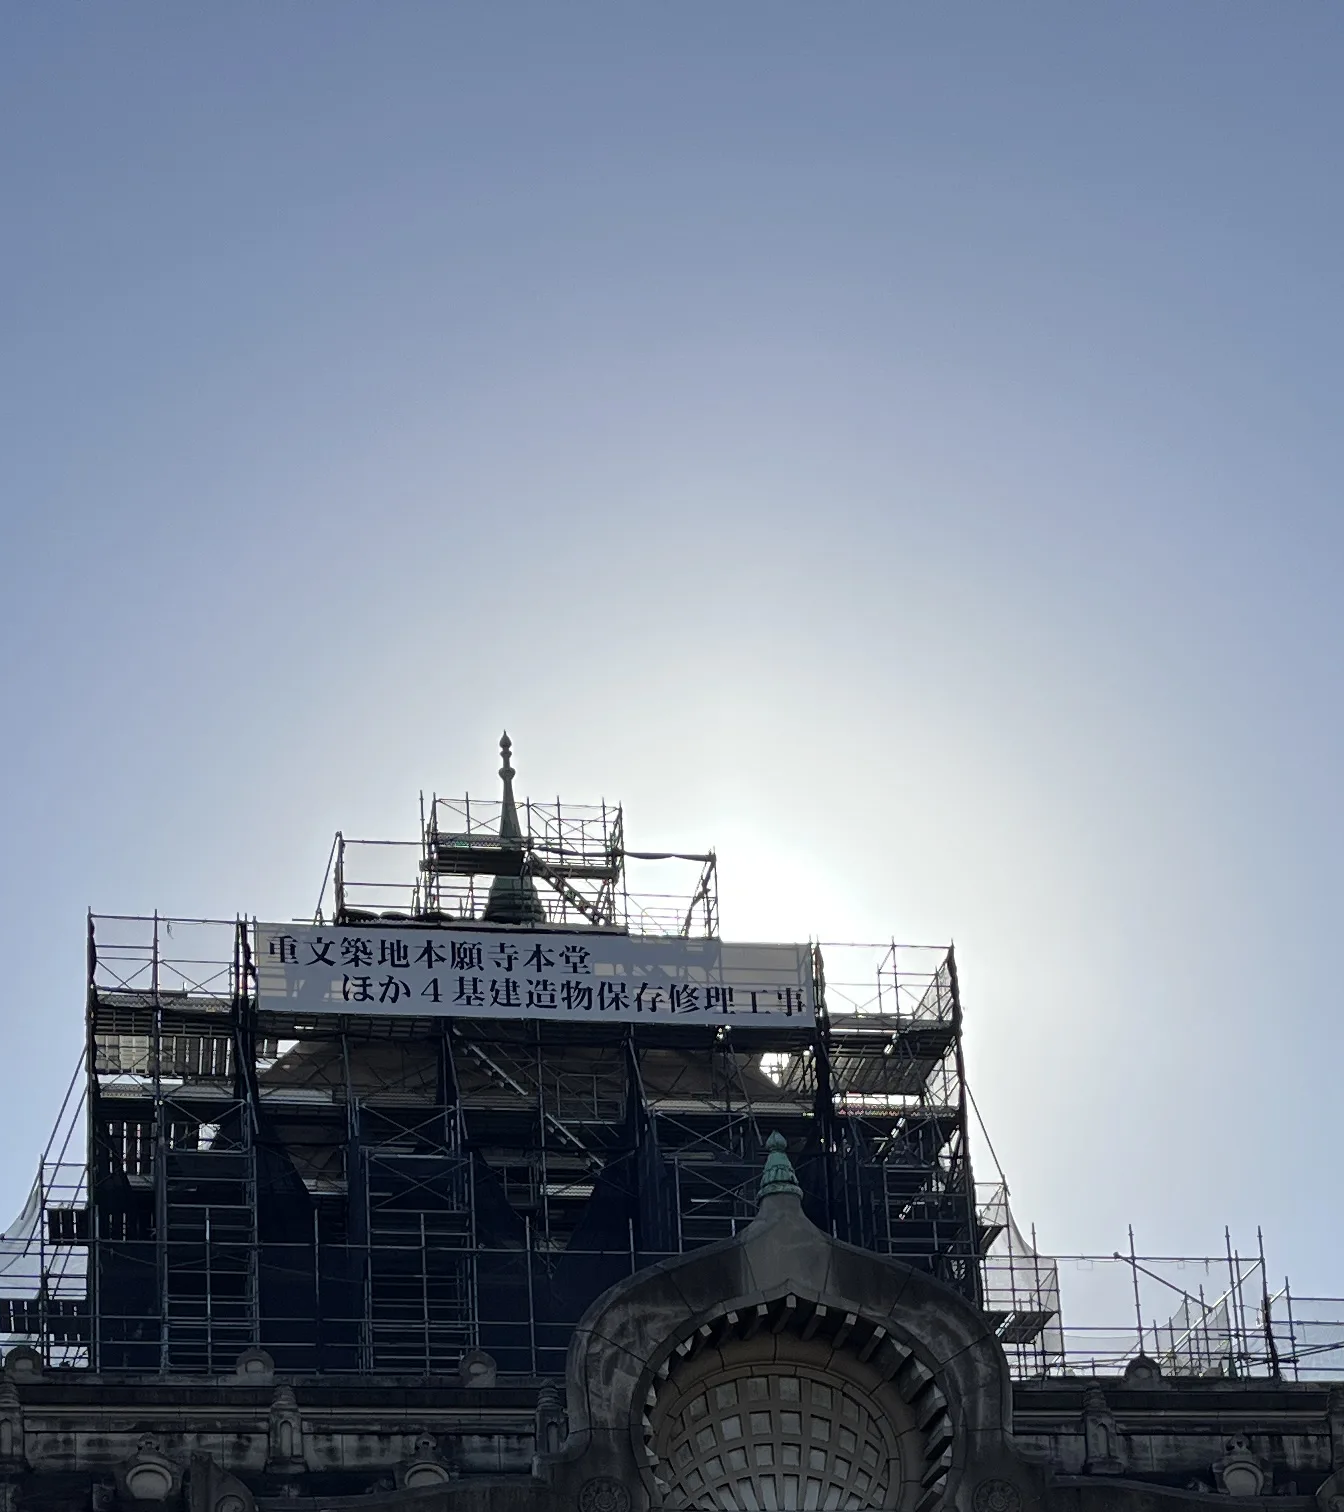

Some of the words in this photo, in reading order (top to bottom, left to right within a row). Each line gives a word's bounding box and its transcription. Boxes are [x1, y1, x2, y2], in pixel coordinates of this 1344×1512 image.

[267, 935, 591, 974] 重文築地本願寺本堂
